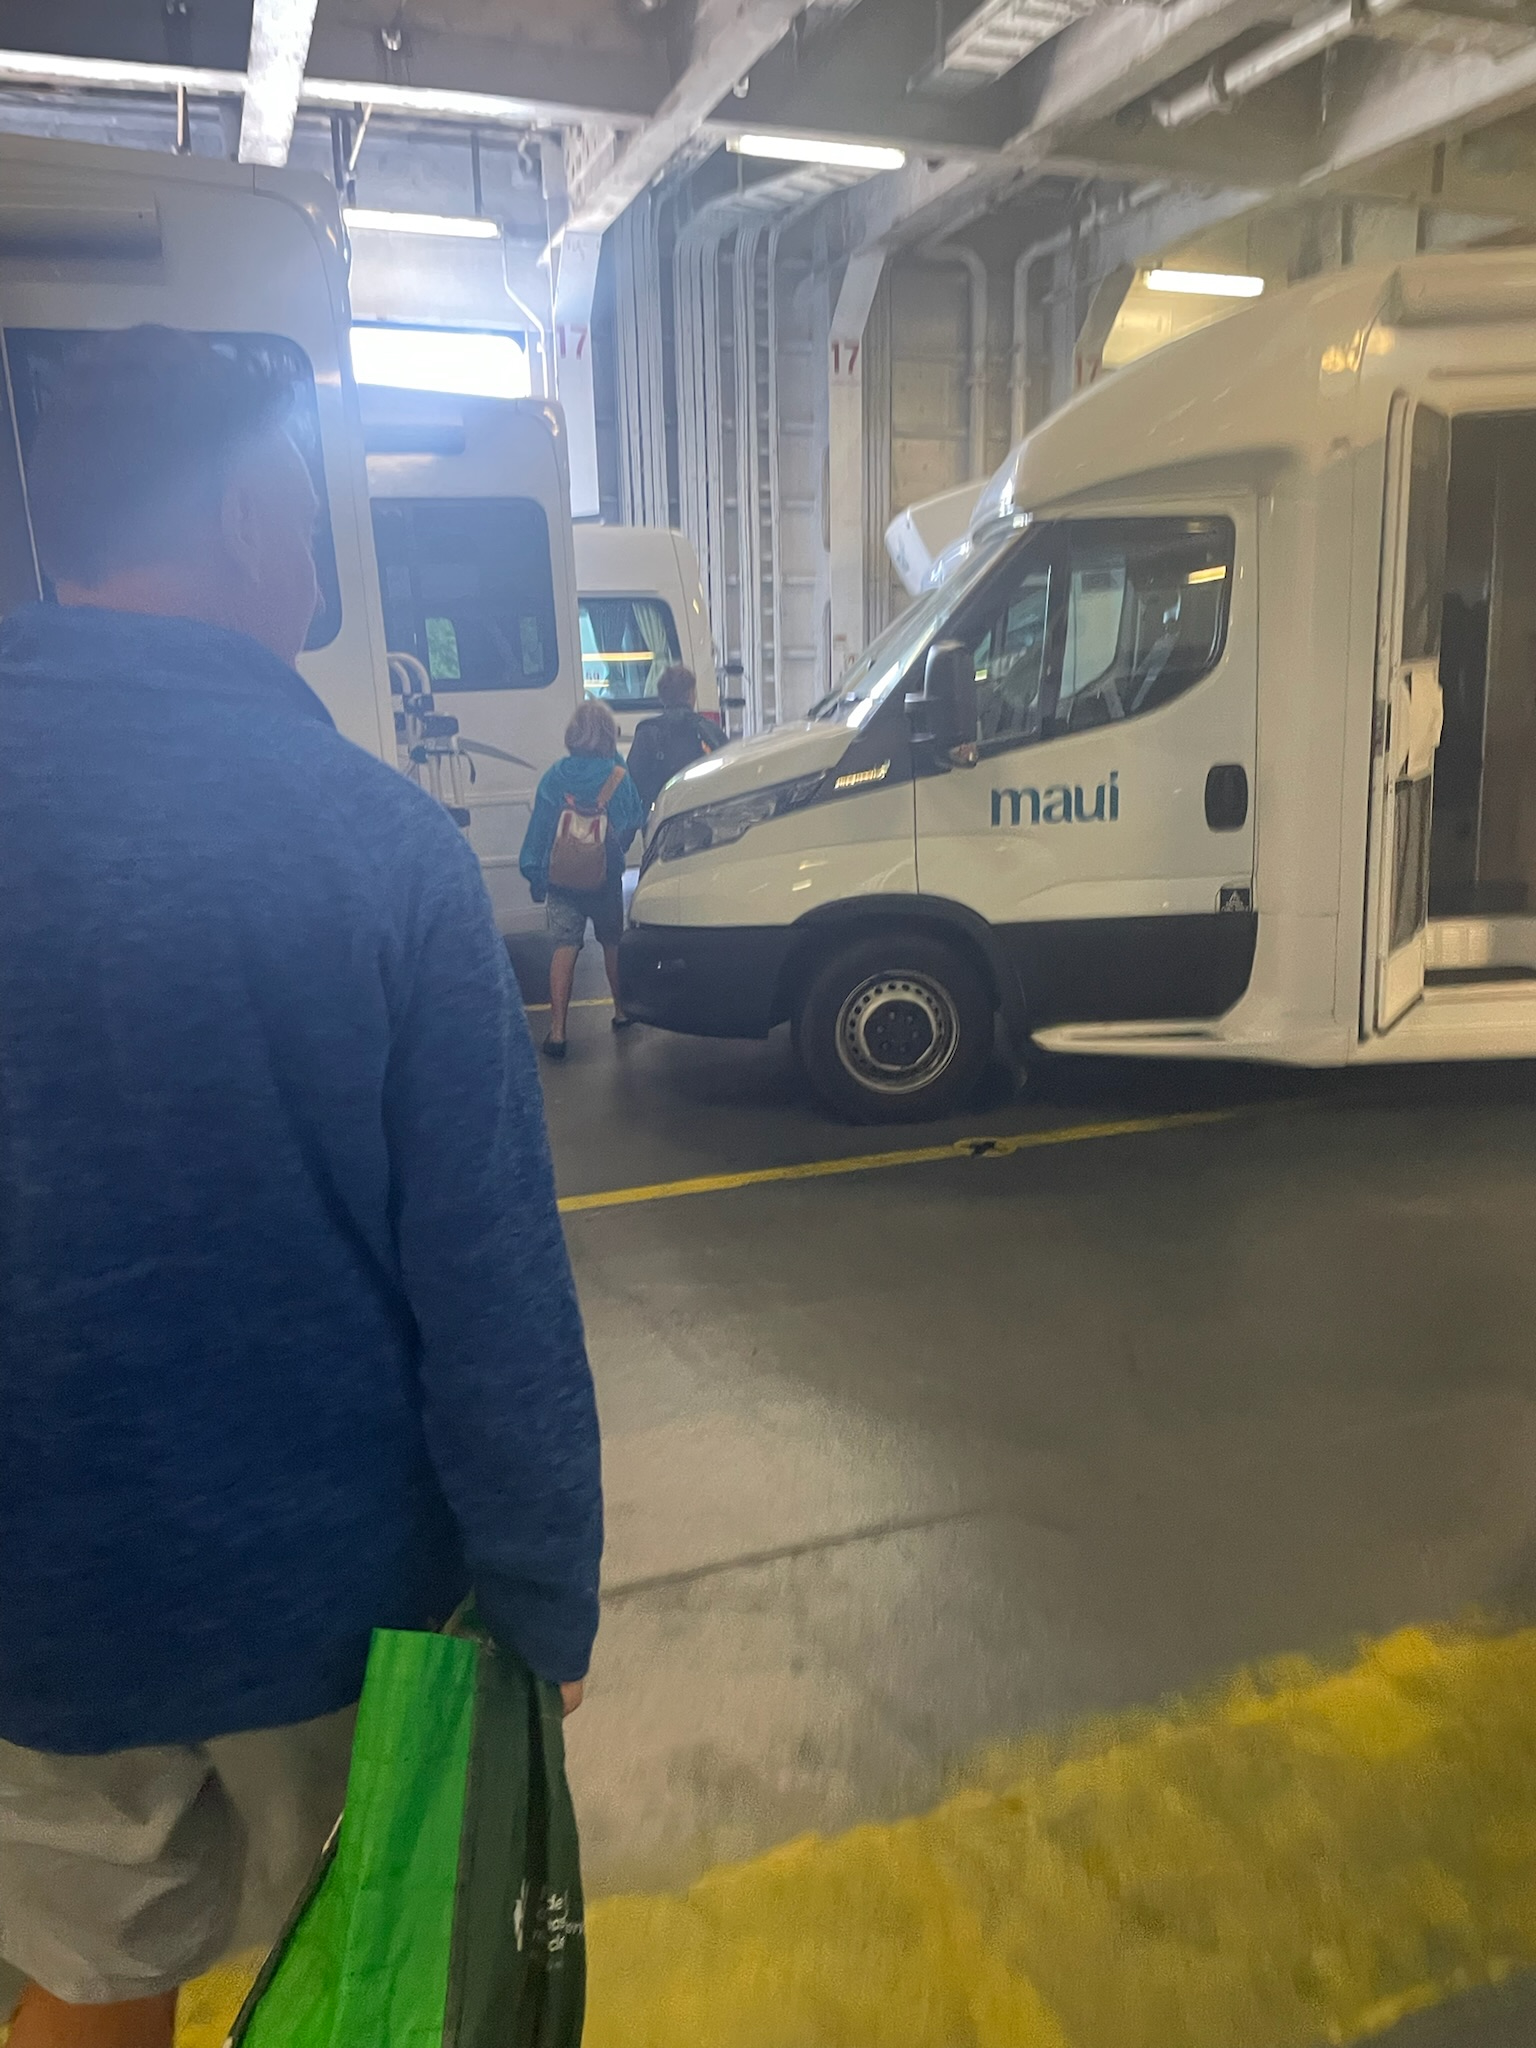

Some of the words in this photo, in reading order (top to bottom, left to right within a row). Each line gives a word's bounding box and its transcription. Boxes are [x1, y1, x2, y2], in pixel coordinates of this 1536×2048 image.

[557, 324, 588, 361] 17
[831, 339, 861, 375] 17
[1075, 353, 1102, 387] 17
[991, 770, 1119, 828] maui
